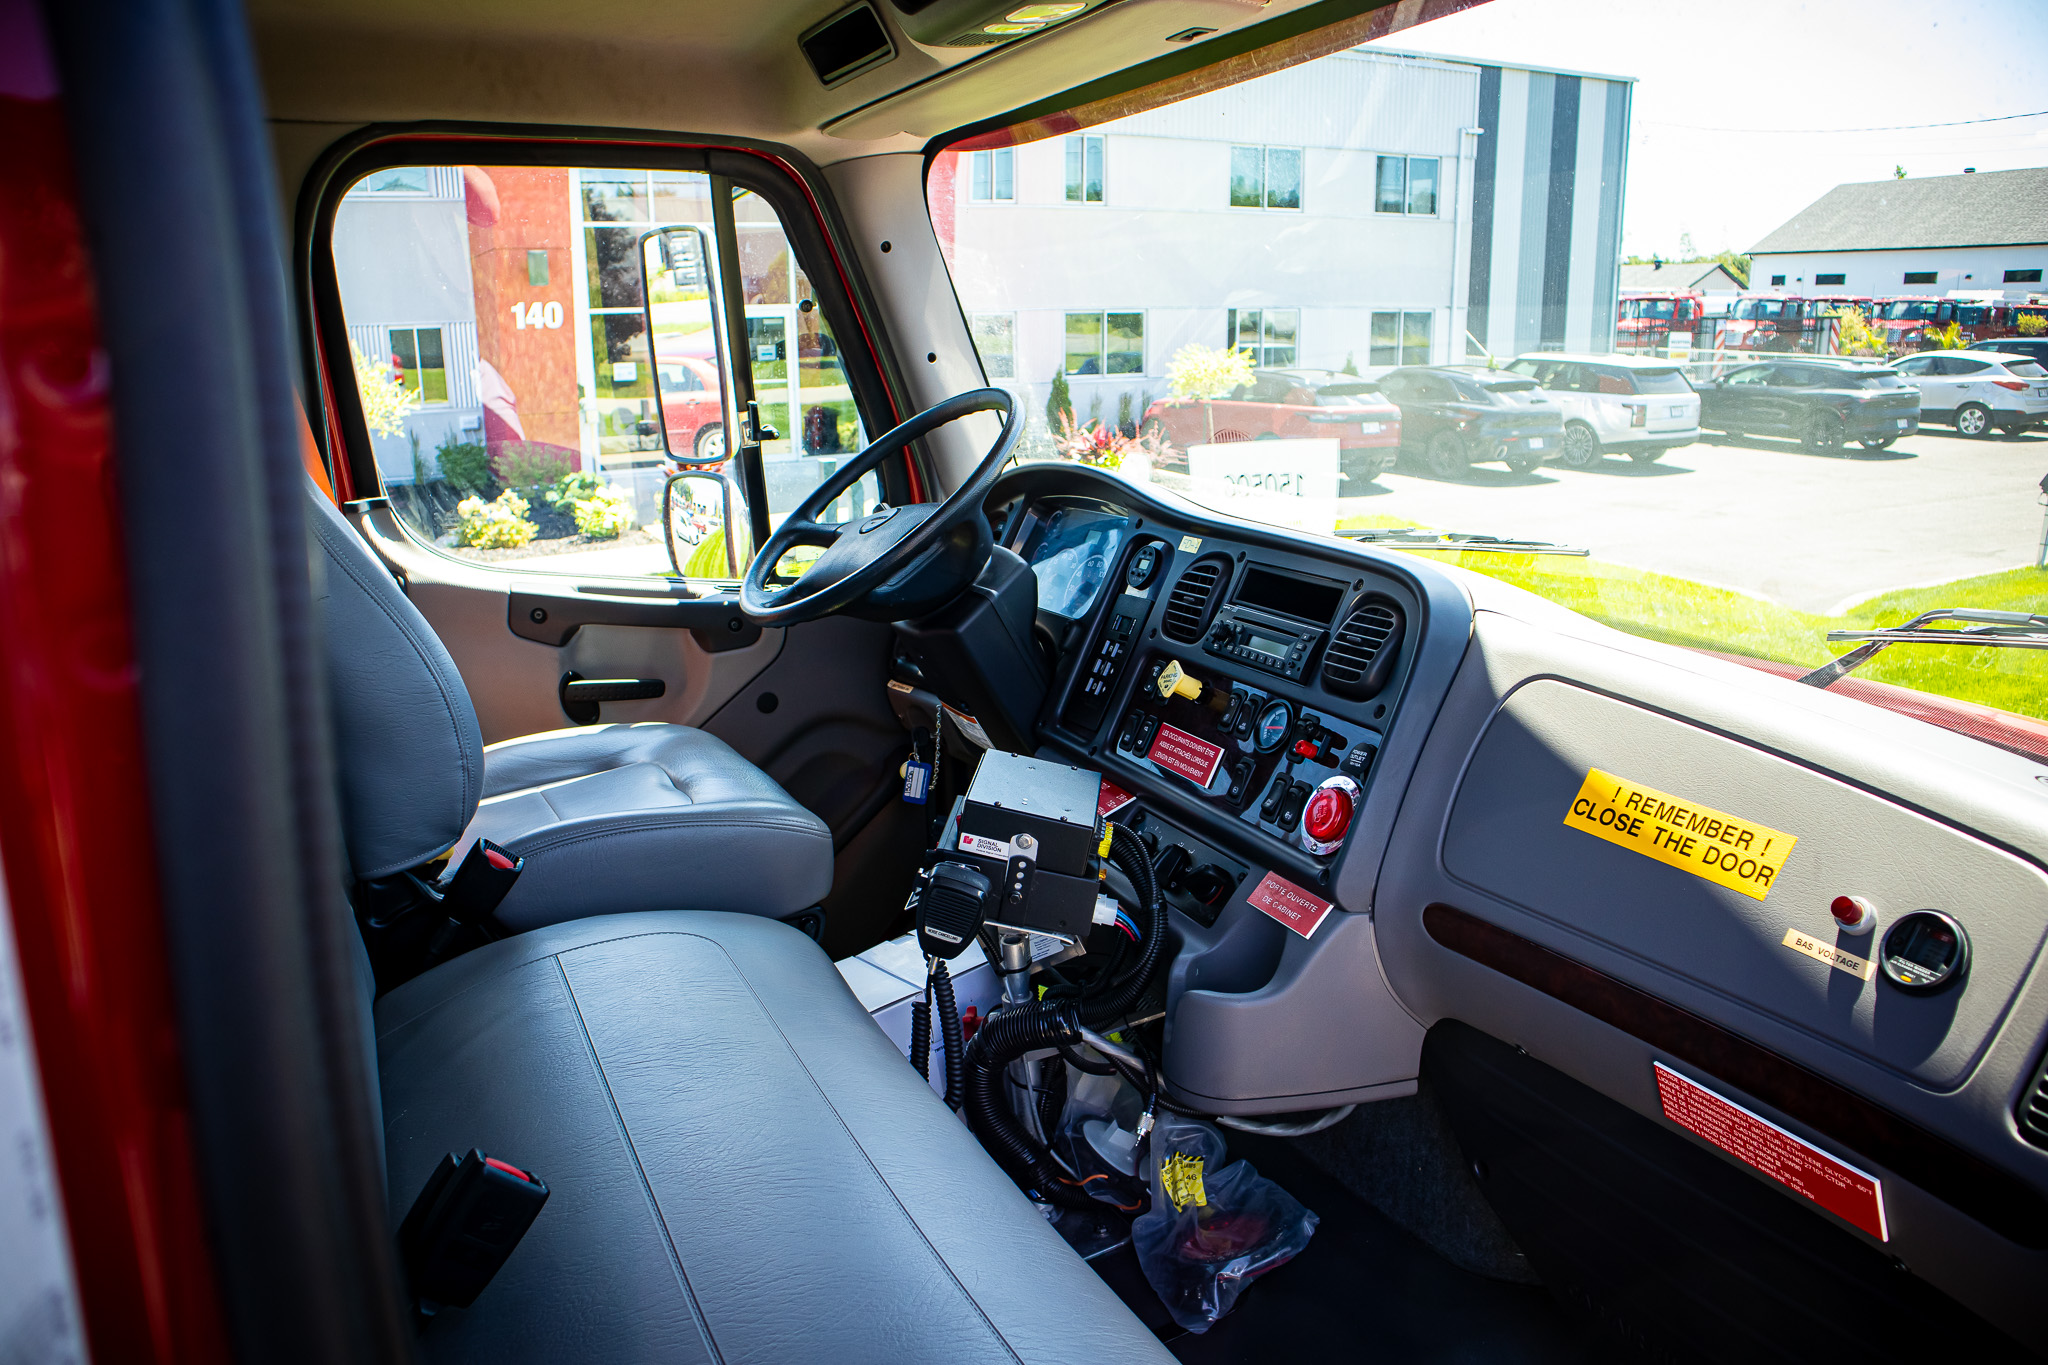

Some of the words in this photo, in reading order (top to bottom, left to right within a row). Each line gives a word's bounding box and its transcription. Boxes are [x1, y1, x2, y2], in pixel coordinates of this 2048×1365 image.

[511, 301, 564, 330] 140
[1168, 732, 1190, 745] OCCUPANTS
[1179, 762, 1203, 778] MOUVEMENT
[1611, 786, 1622, 803] !
[1625, 791, 1755, 851] REMEMBER
[1760, 838, 1772, 856] !
[977, 843, 1001, 853] DIVISION
[978, 838, 998, 847] SIGNAL
[1573, 798, 1645, 837] CLOSE
[1650, 826, 1697, 857] THE
[1702, 845, 1775, 886] DOOR
[1263, 895, 1272, 904] DE
[1272, 901, 1301, 921] CABINET
[1266, 879, 1287, 895] PORTE
[1287, 891, 1317, 913] OUVERTE
[1795, 937, 1813, 951] BAS
[1817, 946, 1860, 971] VOLTAGE
[1659, 1083, 1676, 1095] HUILE
[1661, 1090, 1677, 1102] HUILE
[1656, 1068, 1679, 1083] LIQUIDE
[1689, 1086, 1735, 1114] LUBRIFICATION
[1736, 1111, 1746, 1120] DU
[1779, 1135, 1800, 1149] 15W40
[1662, 1097, 1679, 1110] HUILE
[1680, 1107, 1688, 1115] DE
[1658, 1075, 1680, 1091] LIQUIDE
[1681, 1088, 1689, 1096] DE
[1824, 1166, 1852, 1185] GLYCOL
[1719, 1136, 1732, 1146] DES
[1792, 1176, 1803, 1186] PSI
[1721, 1143, 1733, 1153] DES
[1802, 1189, 1814, 1199] PSI
